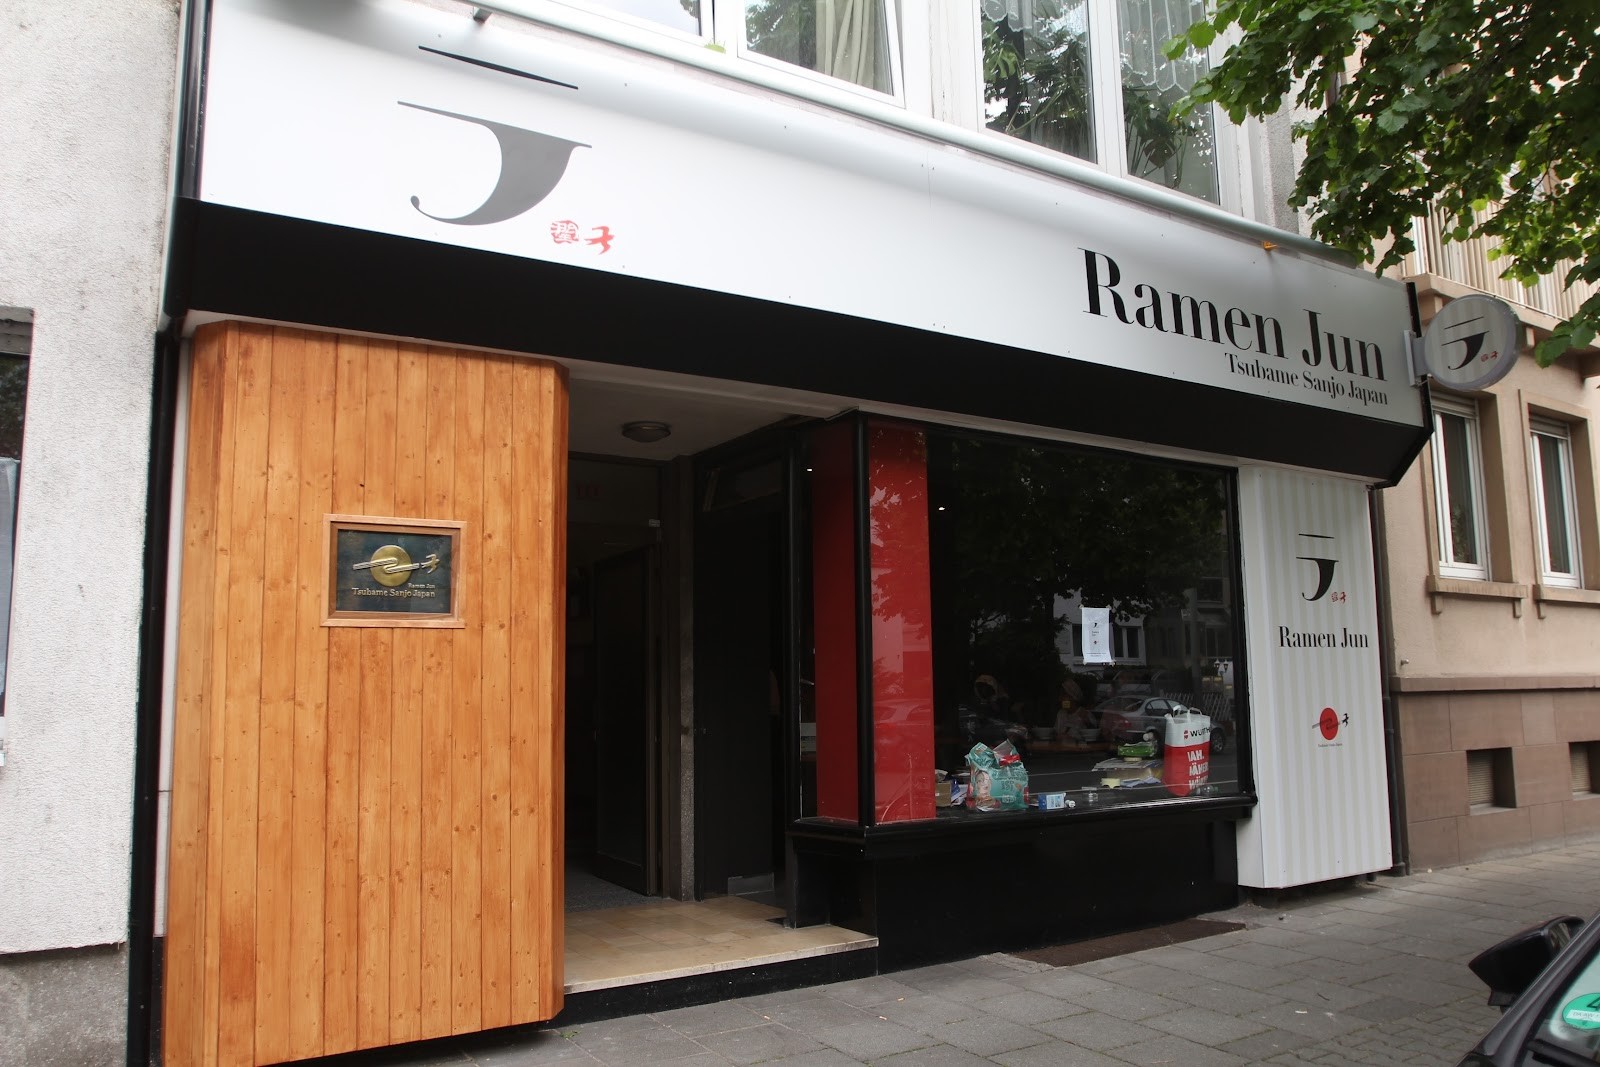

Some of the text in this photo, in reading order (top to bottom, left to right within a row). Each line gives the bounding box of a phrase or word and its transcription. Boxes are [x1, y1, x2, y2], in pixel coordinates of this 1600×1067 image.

[1077, 247, 1388, 382] Ramen Jun
[1224, 352, 1388, 407] Tsubame Sanjo Japan
[351, 587, 436, 599] Tsubame Sanjo Japan
[1278, 625, 1369, 648] Ramen Jun
